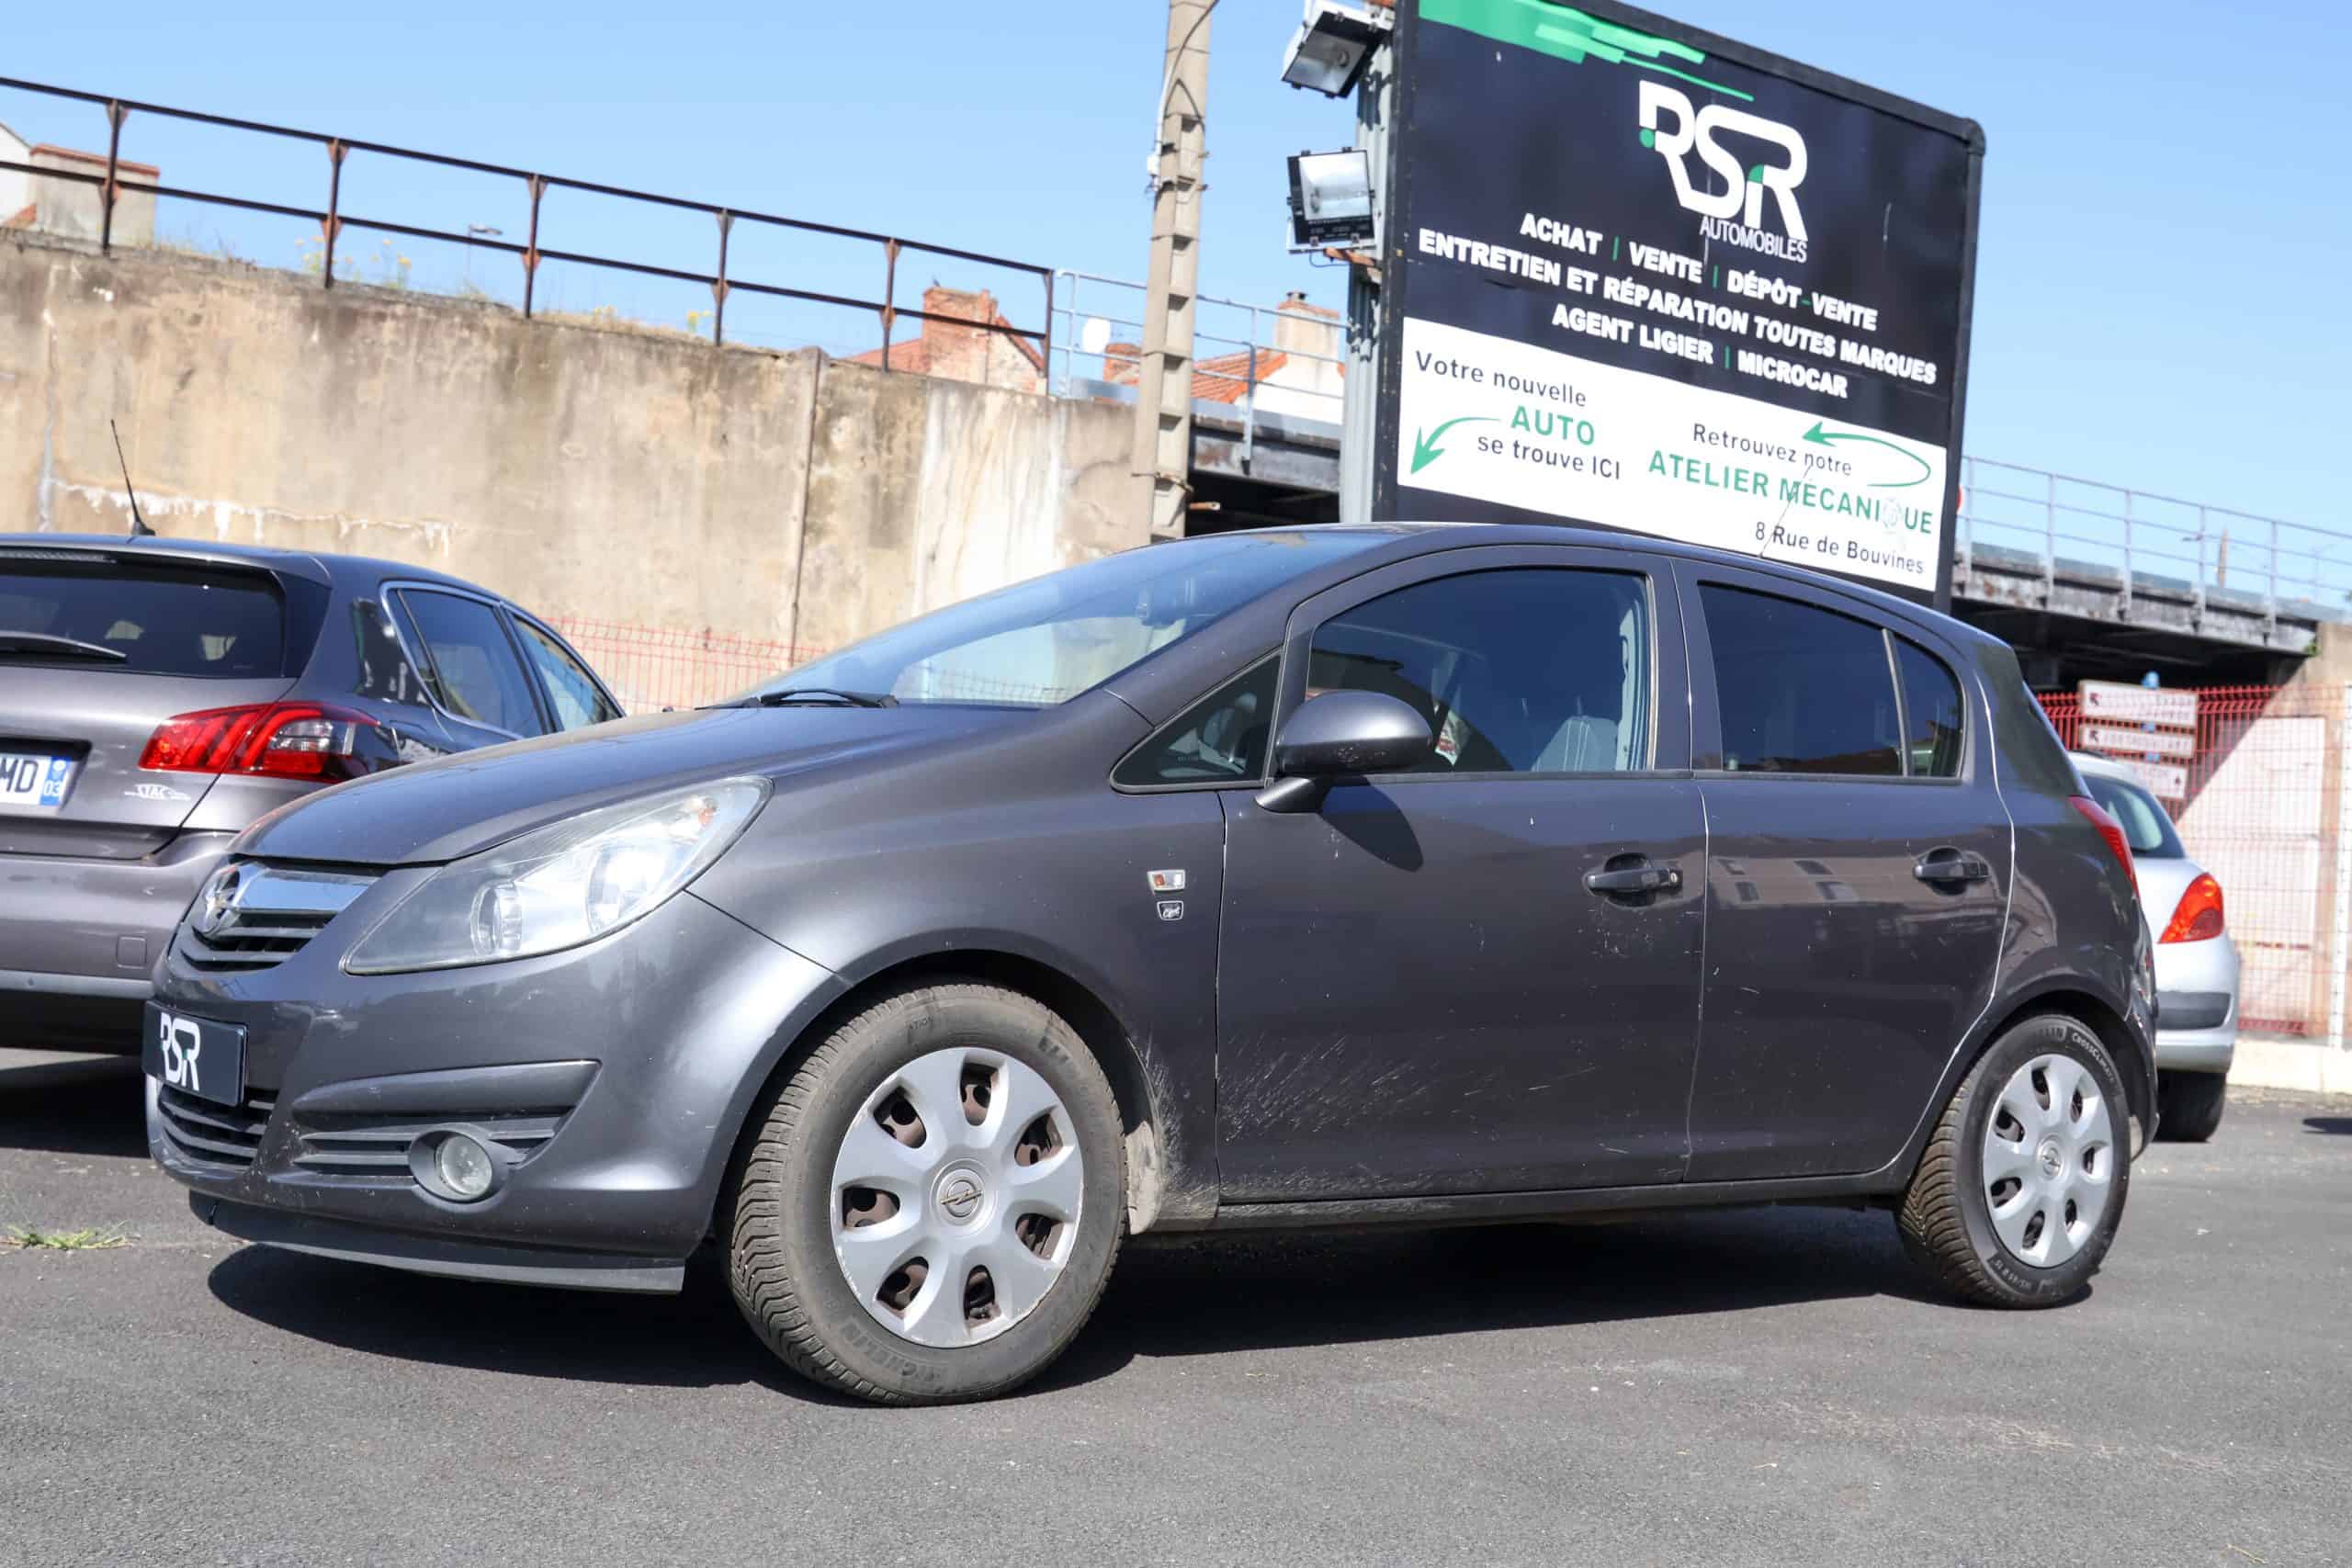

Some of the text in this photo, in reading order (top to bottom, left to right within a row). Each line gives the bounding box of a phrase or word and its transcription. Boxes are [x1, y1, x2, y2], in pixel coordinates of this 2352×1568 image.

[1639, 80, 1808, 242] RSR
[1520, 213, 1603, 254] ACHAT
[1629, 242, 1703, 284] VENTE
[1700, 215, 1807, 263] AUTOMOBILES
[1419, 228, 1937, 385] ENTRETIEN ET RÉPARATION TOUTES MARQUES
[1552, 303, 1849, 399] AGENT LIGIER MICROCAR
[1416, 350, 1587, 407] Votre nouvelle
[1510, 405, 1595, 446] AUTO
[1693, 423, 1852, 476] Retrouvez notre
[1477, 435, 1620, 480] se trouve ICI
[1648, 450, 1770, 498] ATELIER
[1756, 522, 1925, 574] 8 Rue de Bouvines
[44, 780, 62, 796] 03
[160, 1011, 200, 1091] RSR
